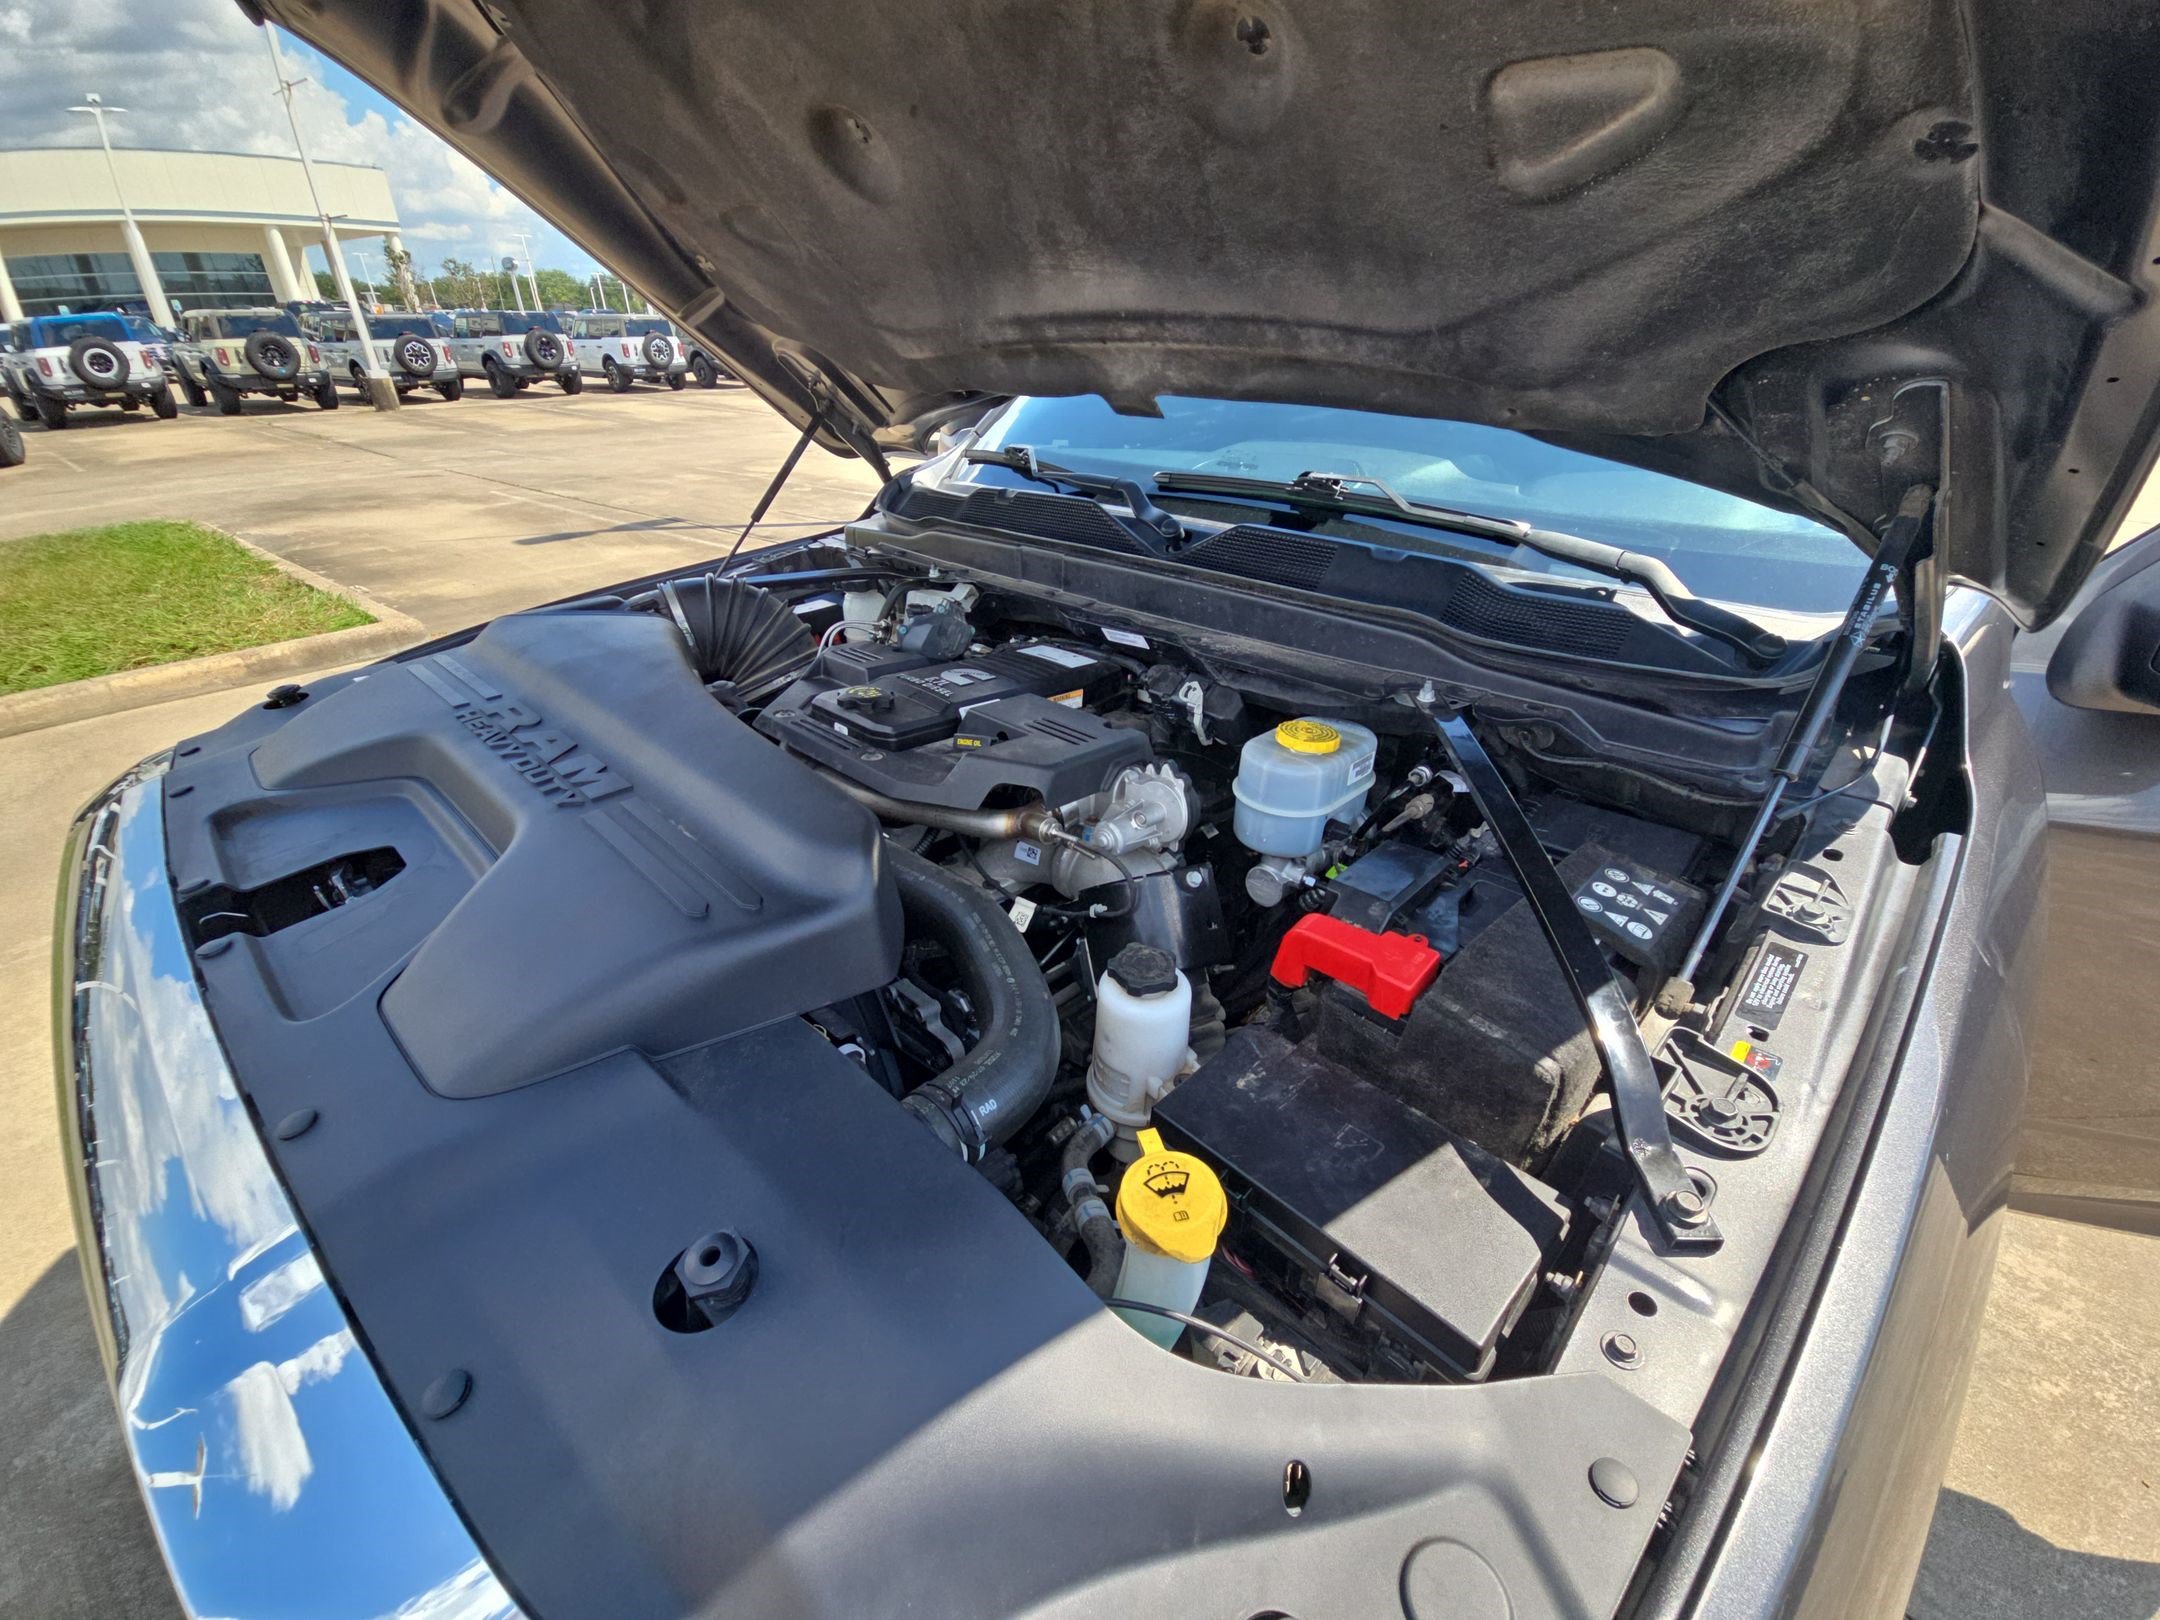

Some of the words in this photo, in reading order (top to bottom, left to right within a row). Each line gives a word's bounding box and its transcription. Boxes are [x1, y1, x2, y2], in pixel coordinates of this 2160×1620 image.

[455, 709, 527, 758] HEAVY
[510, 757, 587, 807] DUTY
[486, 700, 634, 803] RAM
[978, 1098, 998, 1117] RAD
